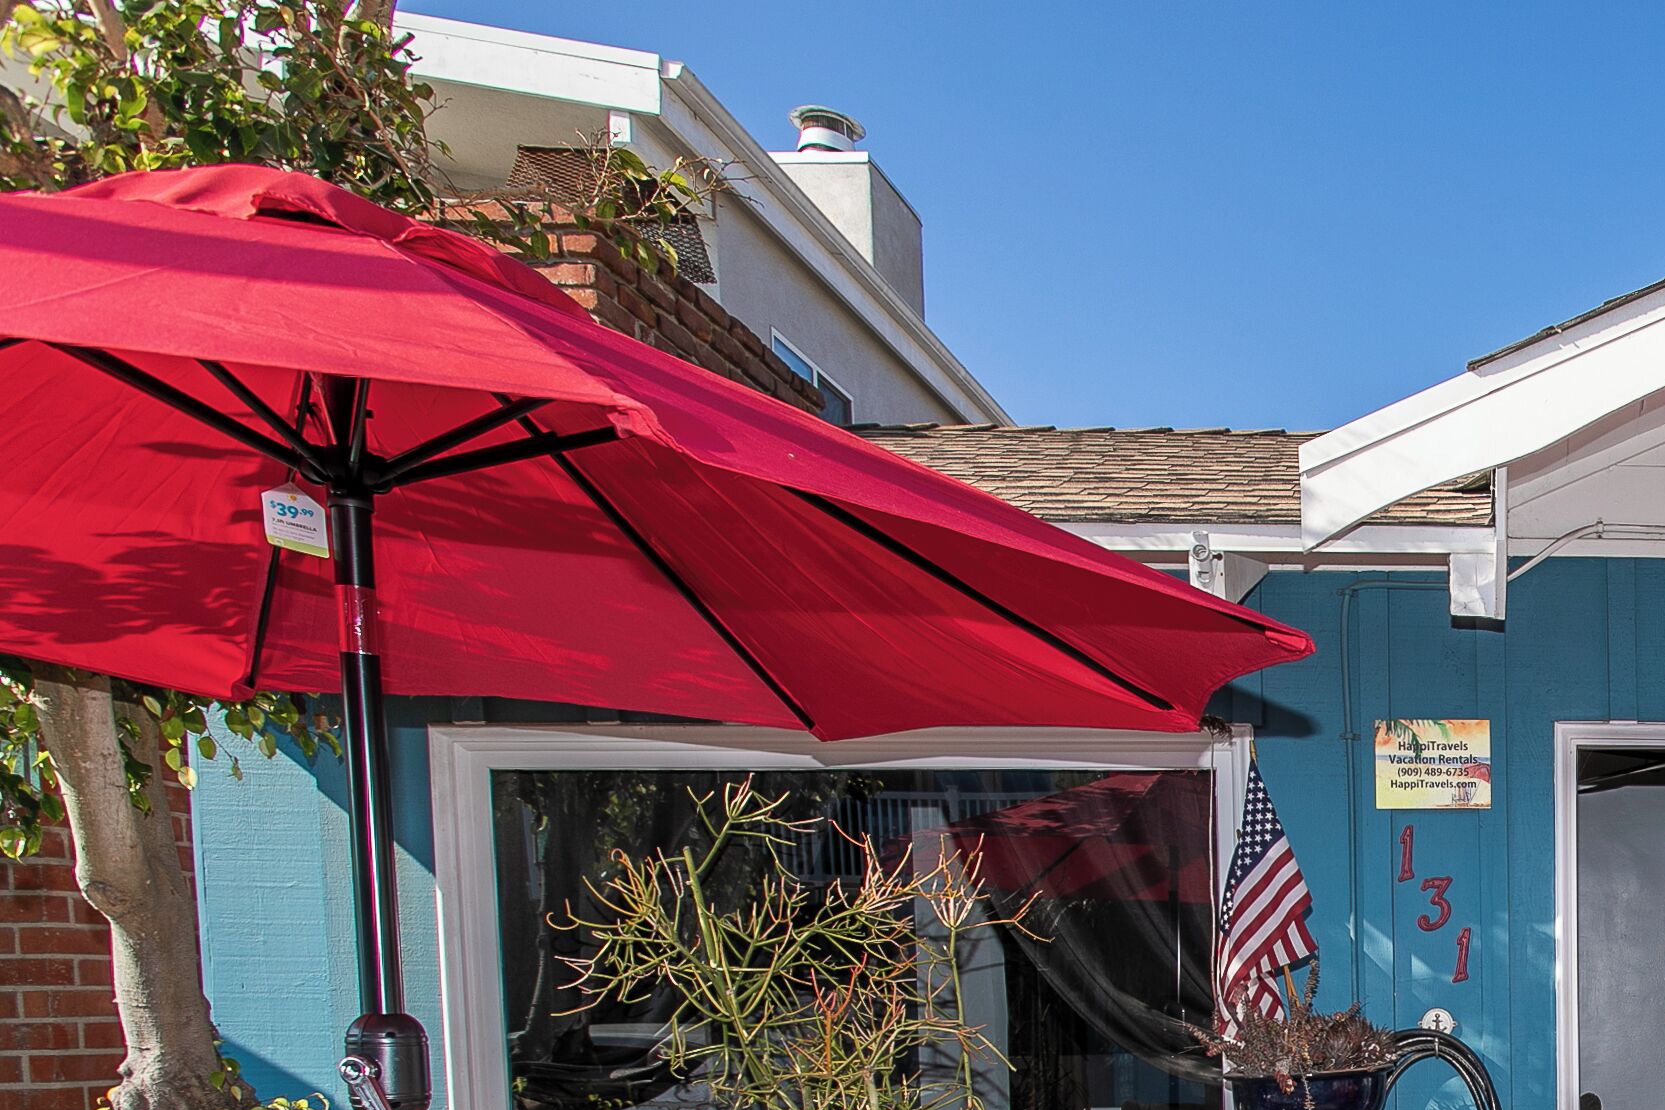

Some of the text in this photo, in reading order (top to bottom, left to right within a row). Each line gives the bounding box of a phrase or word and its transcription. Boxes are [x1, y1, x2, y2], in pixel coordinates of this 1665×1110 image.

[270, 500, 314, 518] $39.99
[286, 521, 317, 532] UMBRELLA
[1398, 741, 1468, 754] HappiTravels
[1388, 754, 1478, 765] Vacation Rentals
[1397, 767, 1469, 778] (909) 489-6735
[1390, 779, 1477, 791] HappiTravels.com
